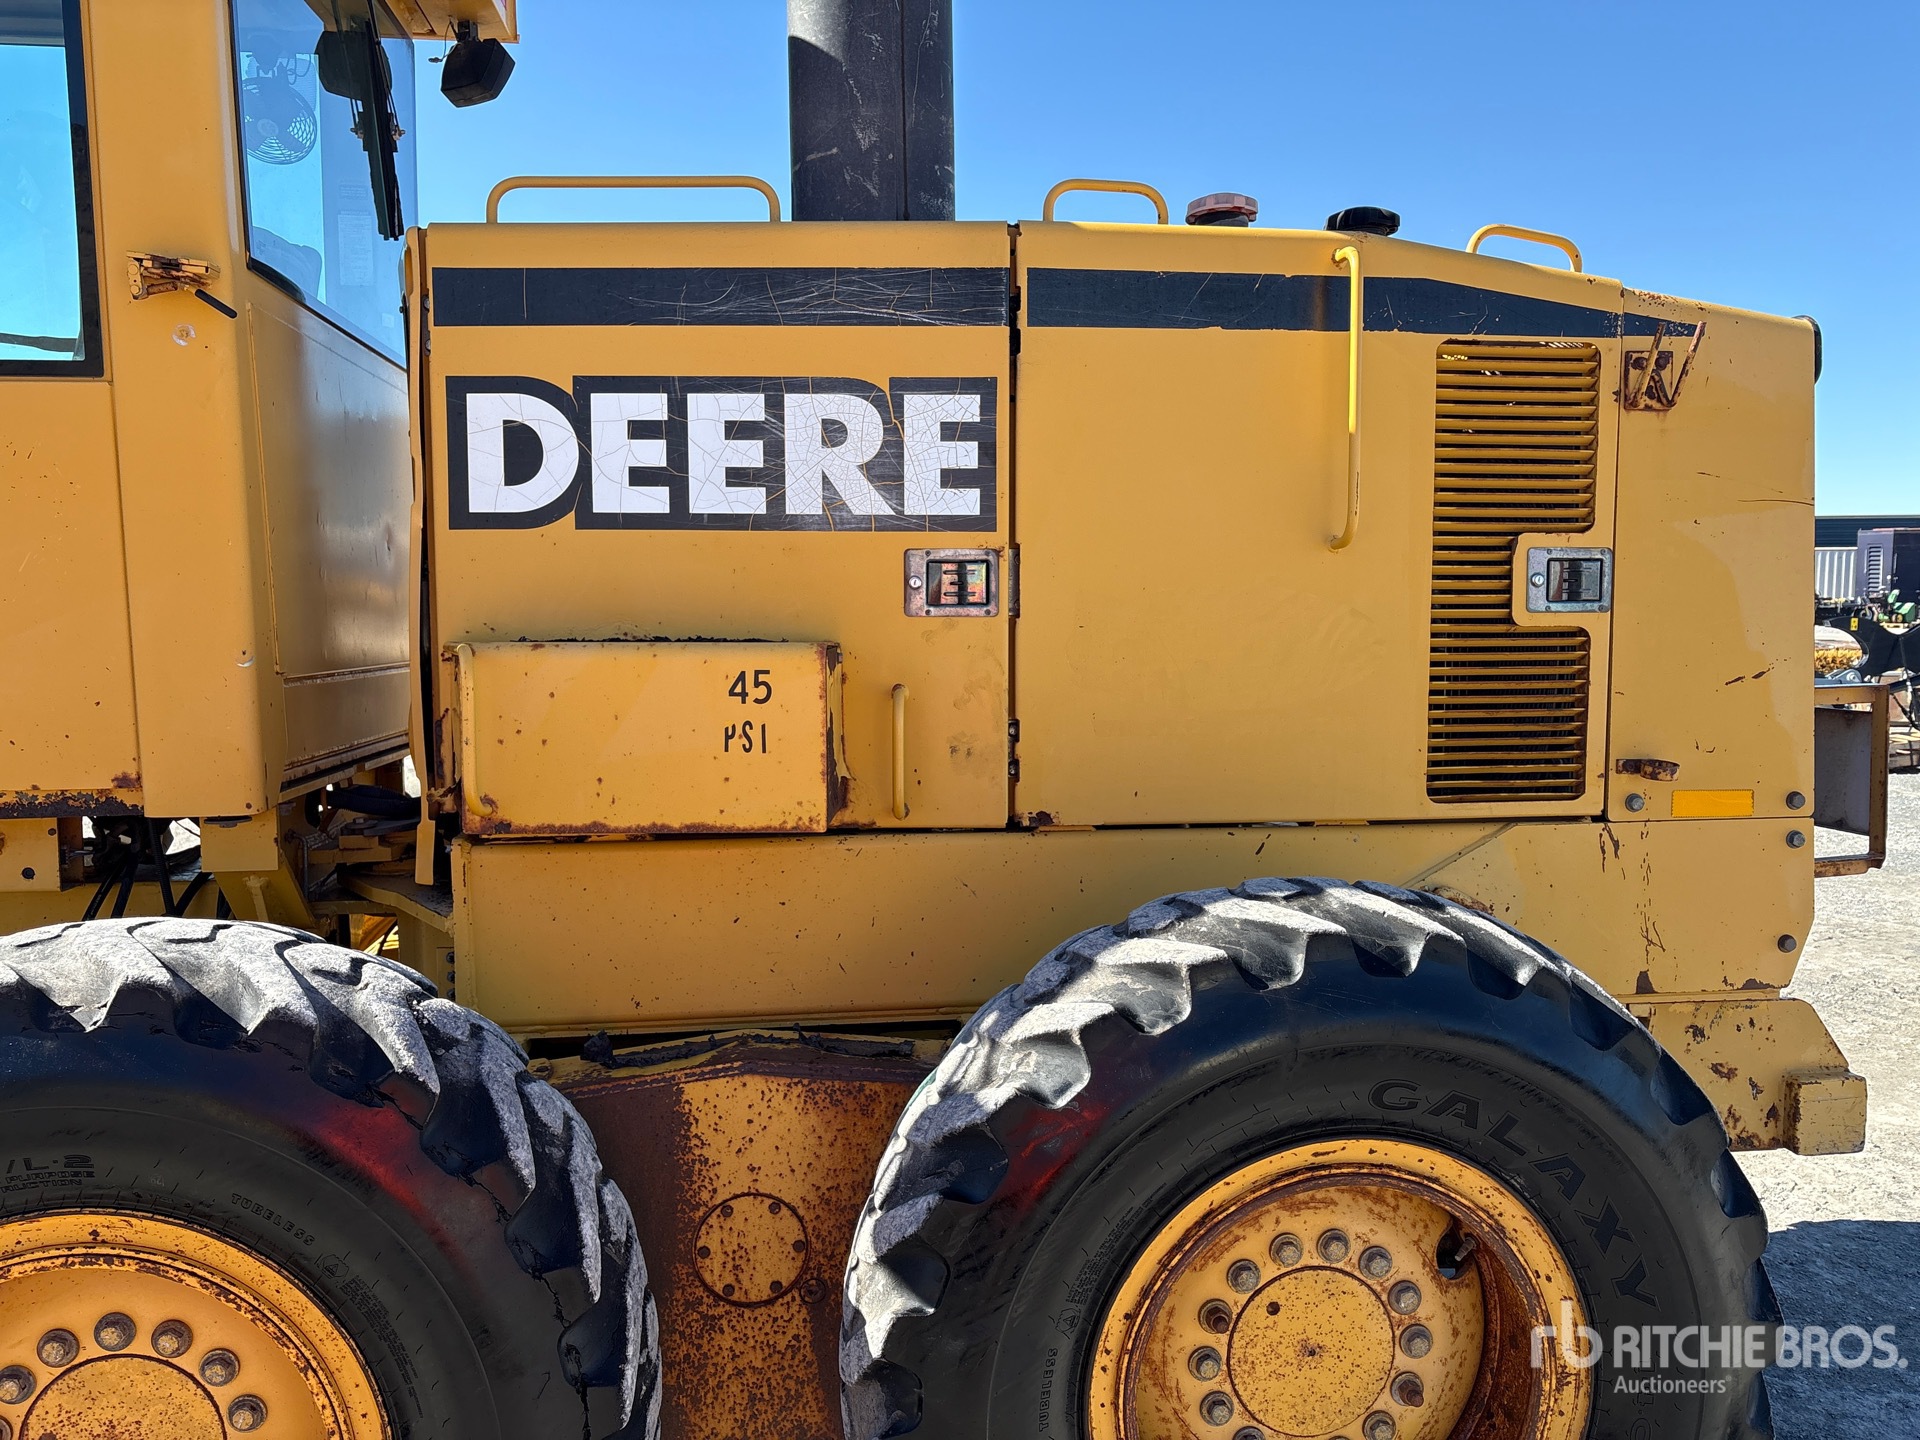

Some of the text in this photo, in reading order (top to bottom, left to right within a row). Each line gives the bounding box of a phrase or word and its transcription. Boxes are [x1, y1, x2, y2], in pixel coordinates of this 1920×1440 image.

[466, 392, 981, 516] DEERE
[728, 669, 773, 705] 45
[724, 720, 767, 754] PSI
[5, 1170, 96, 1184] PURPOSE
[1367, 1078, 1662, 1312] GALAXY
[231, 1192, 317, 1246] TUBELESS
[1038, 1347, 1059, 1433] TUBELESS
